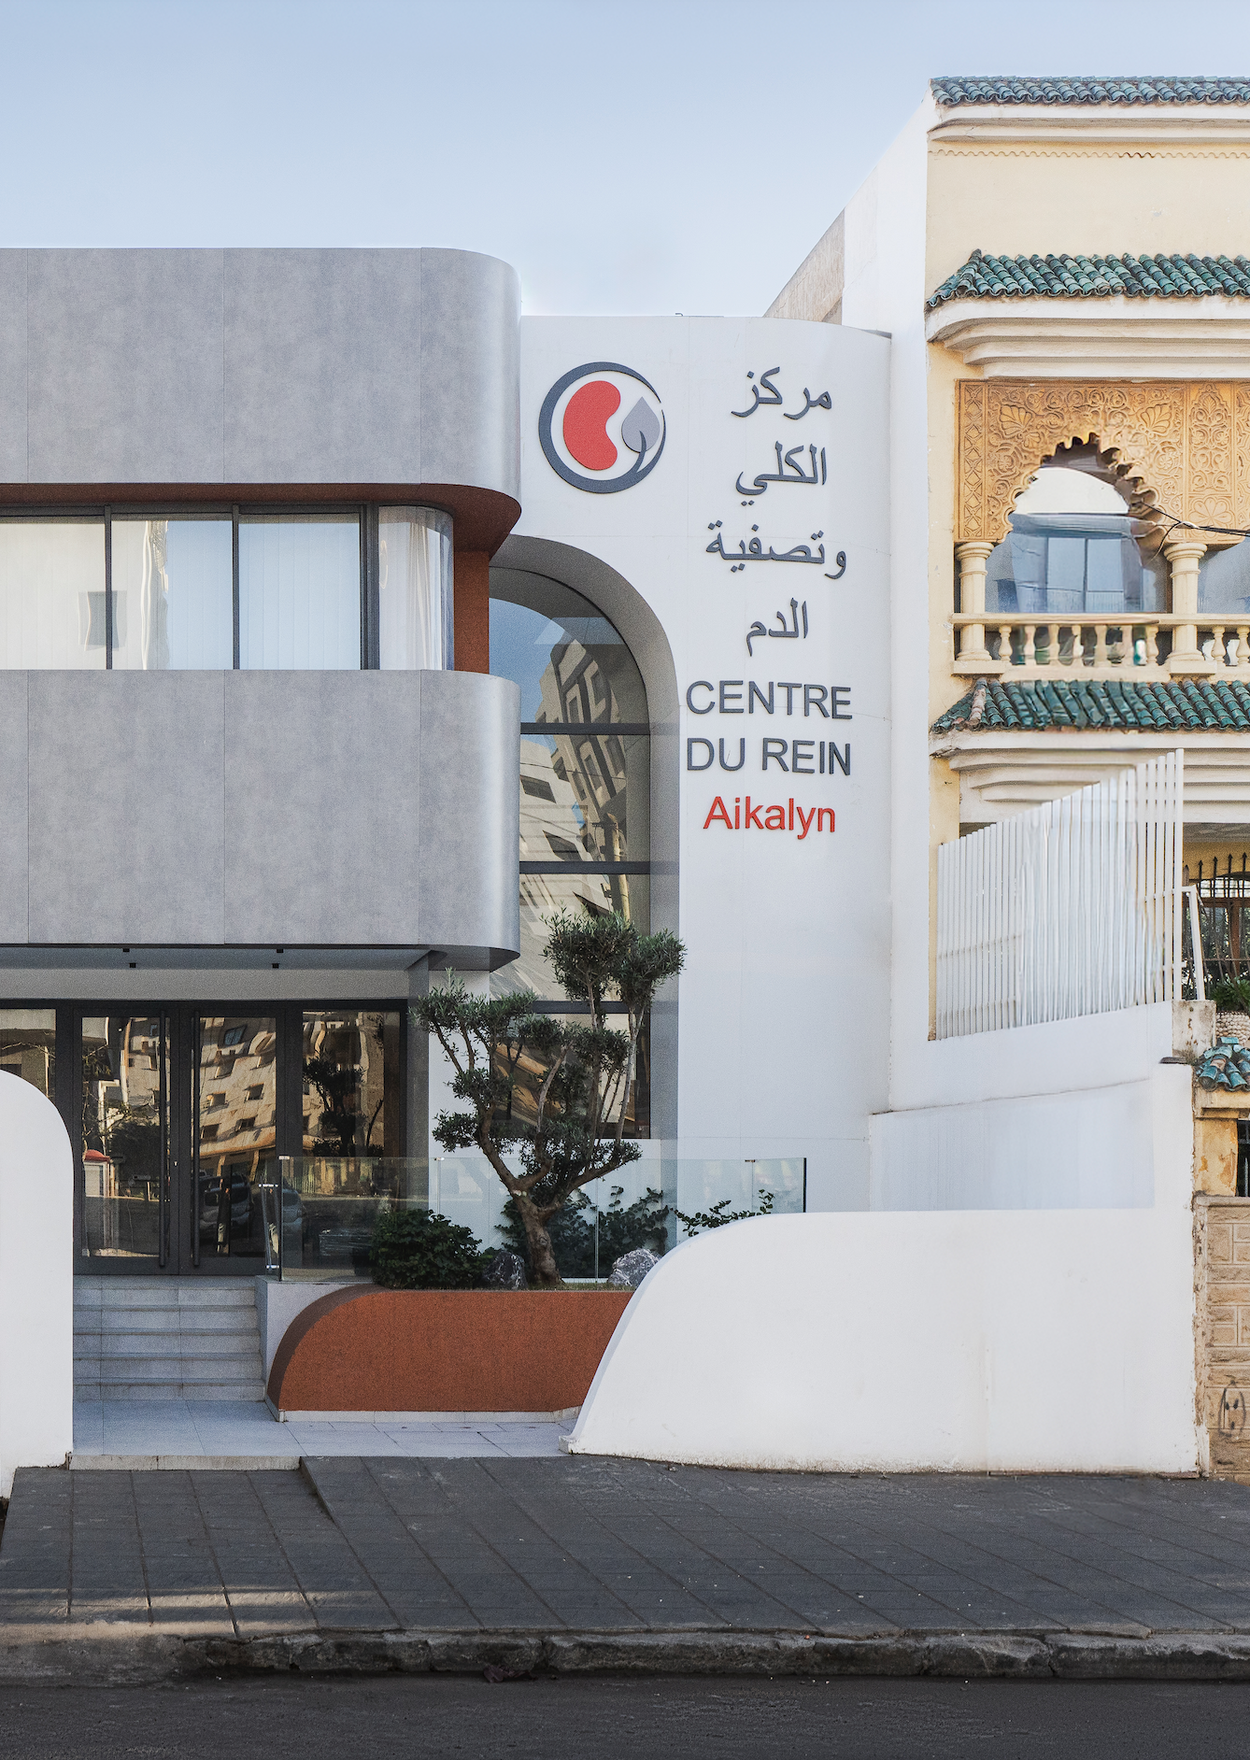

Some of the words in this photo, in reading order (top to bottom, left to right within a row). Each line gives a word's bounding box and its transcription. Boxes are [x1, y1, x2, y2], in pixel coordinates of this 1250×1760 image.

[730, 366, 833, 421] مركز
[705, 519, 848, 580] وتصفية
[745, 597, 809, 657] الدم
[685, 680, 853, 721] CENTRE
[686, 737, 746, 772] DU
[761, 737, 851, 777] REIN
[702, 795, 837, 841] Aikalyn
